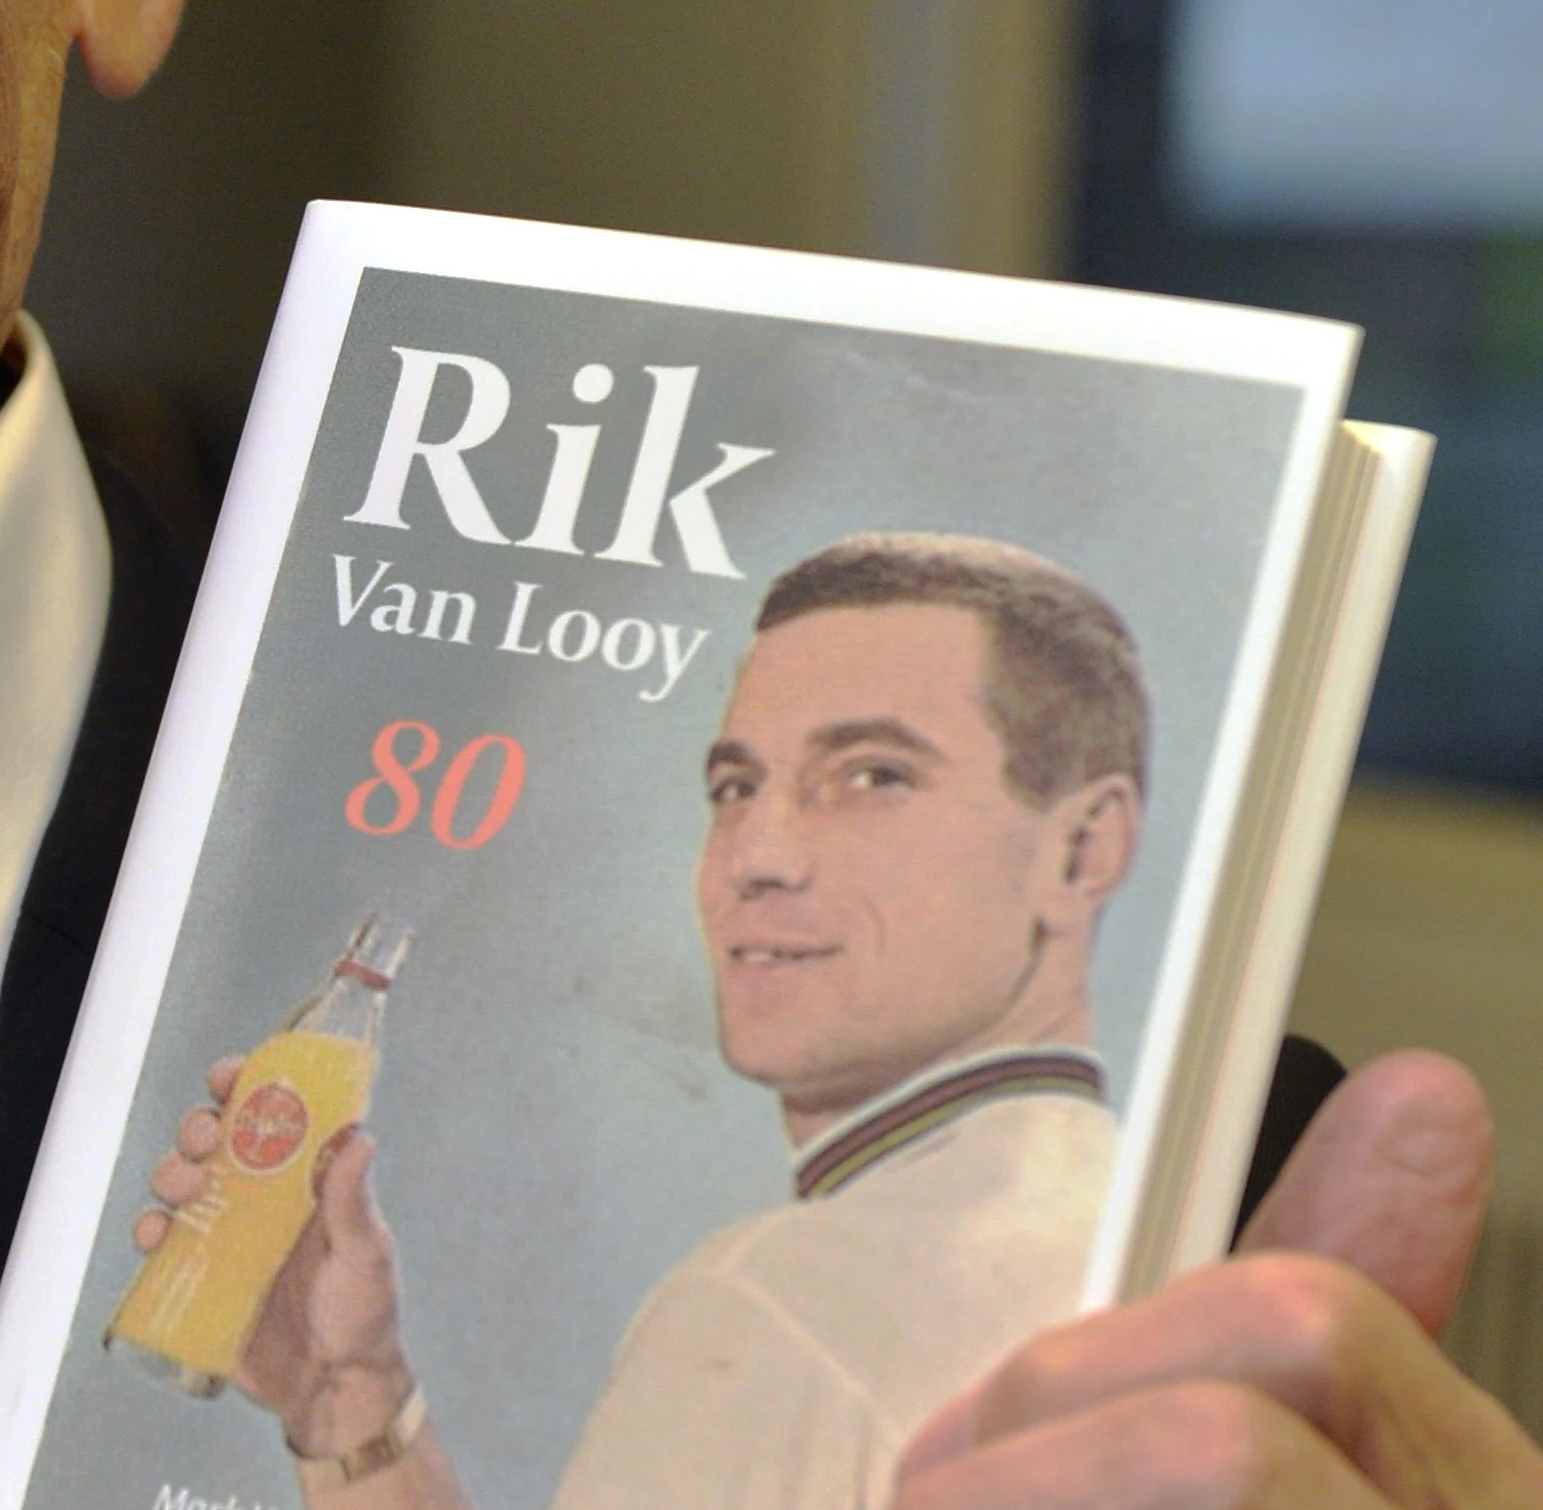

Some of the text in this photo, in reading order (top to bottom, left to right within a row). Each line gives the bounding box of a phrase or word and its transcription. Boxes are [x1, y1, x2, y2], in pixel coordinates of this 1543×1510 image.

[342, 346, 777, 580] Rik
[332, 553, 711, 702] Van Looy
[344, 718, 527, 850] 80
